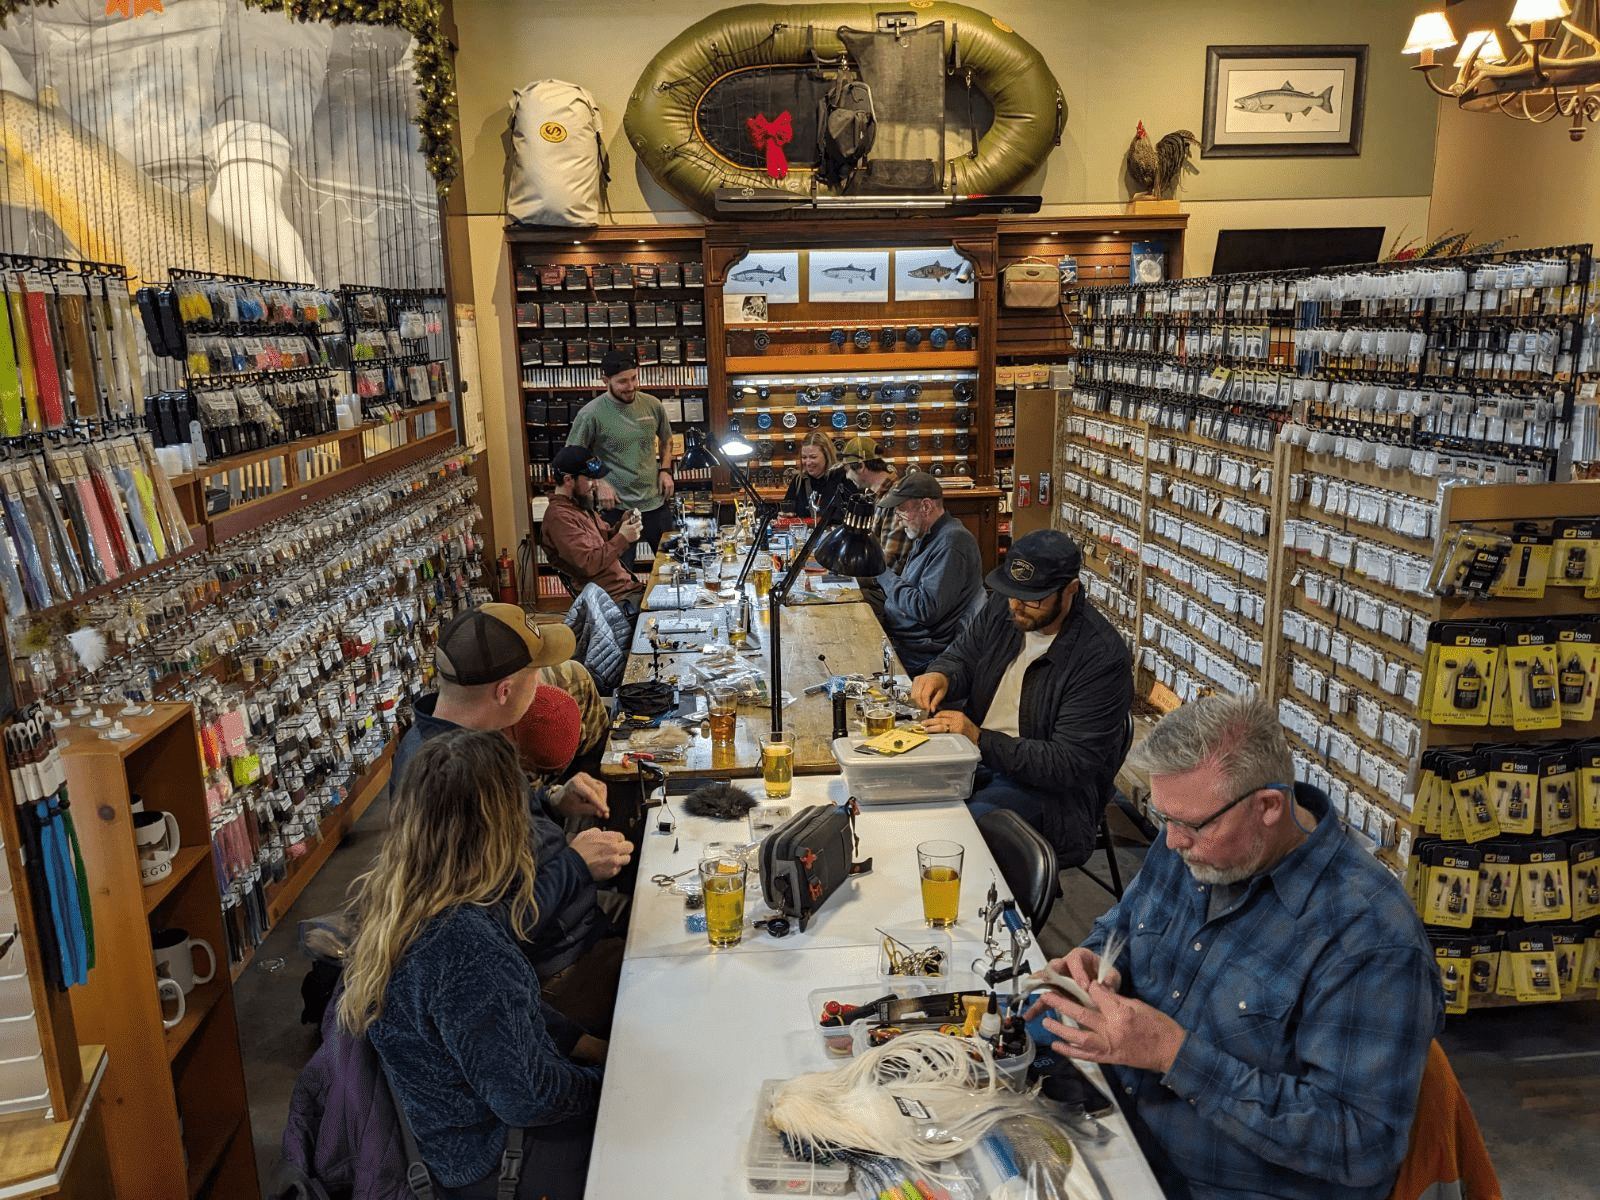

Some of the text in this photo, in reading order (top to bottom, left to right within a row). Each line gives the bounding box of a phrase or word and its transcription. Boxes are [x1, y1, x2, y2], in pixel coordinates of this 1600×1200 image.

[1577, 529, 1592, 537] loon
[1470, 636, 1487, 644] loon
[1575, 632, 1592, 640] loon
[1542, 852, 1556, 860] loon
[1456, 858, 1469, 866] loon
[1531, 941, 1544, 949] loon
